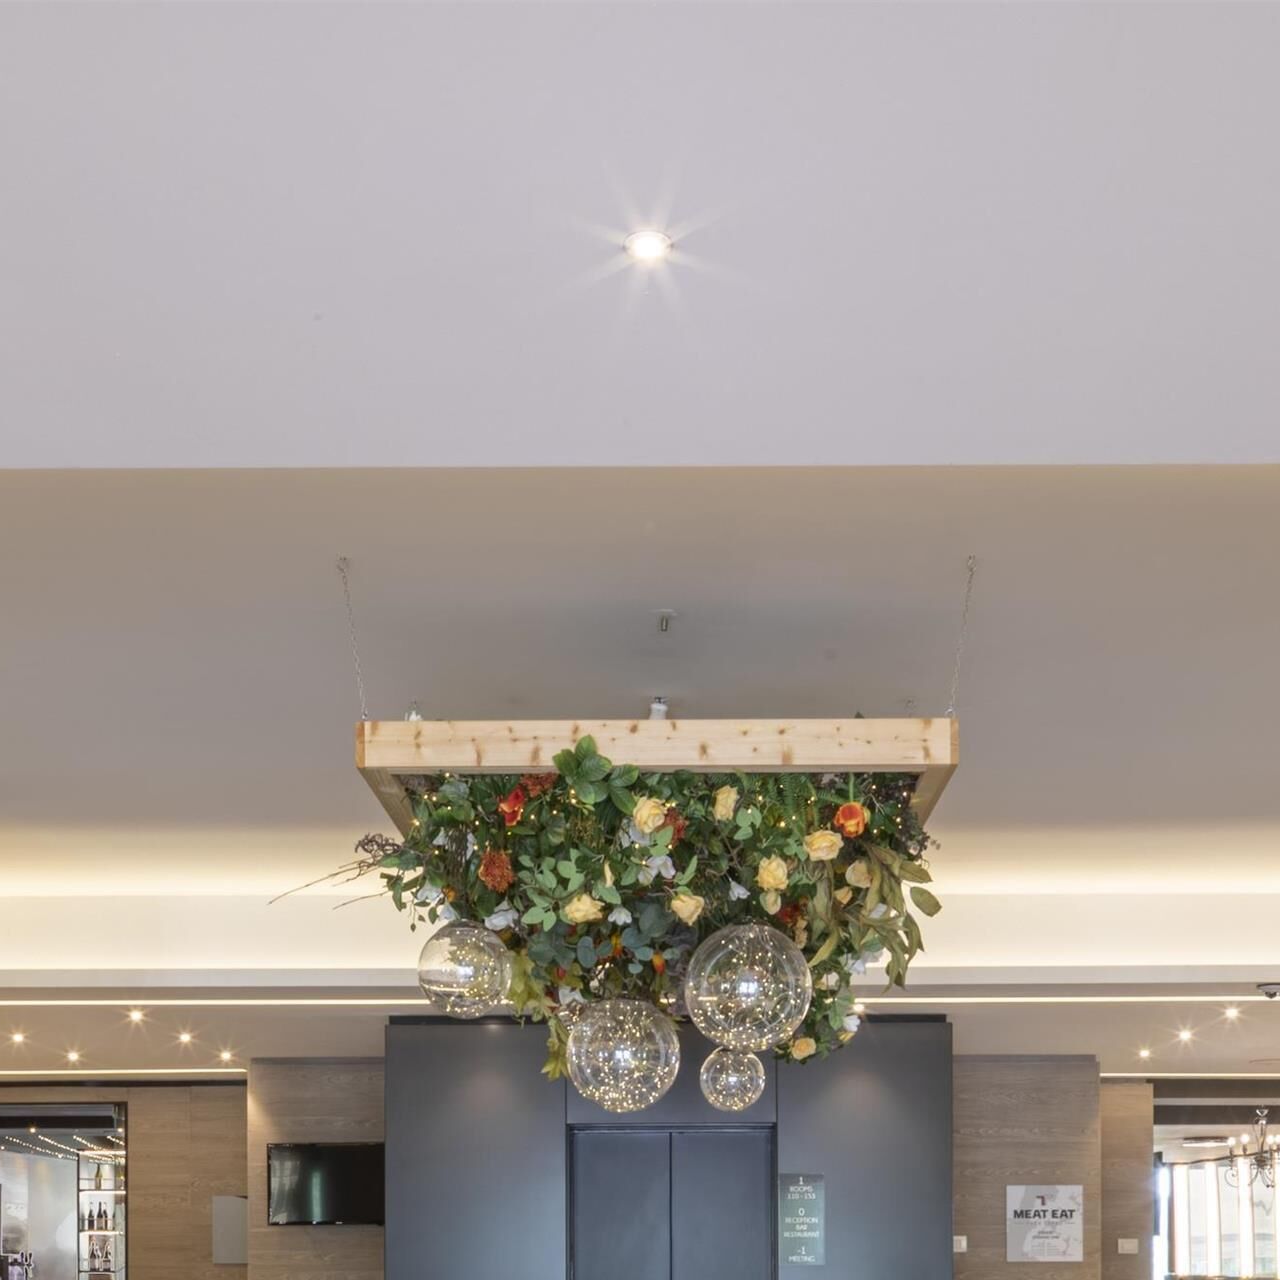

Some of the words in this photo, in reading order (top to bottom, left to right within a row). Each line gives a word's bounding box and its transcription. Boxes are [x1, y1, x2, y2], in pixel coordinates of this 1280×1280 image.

[799, 1176, 804, 1185] 1
[798, 1207, 805, 1216] 0
[1014, 1209, 1049, 1219] MEAT
[1051, 1209, 1076, 1219] EAT
